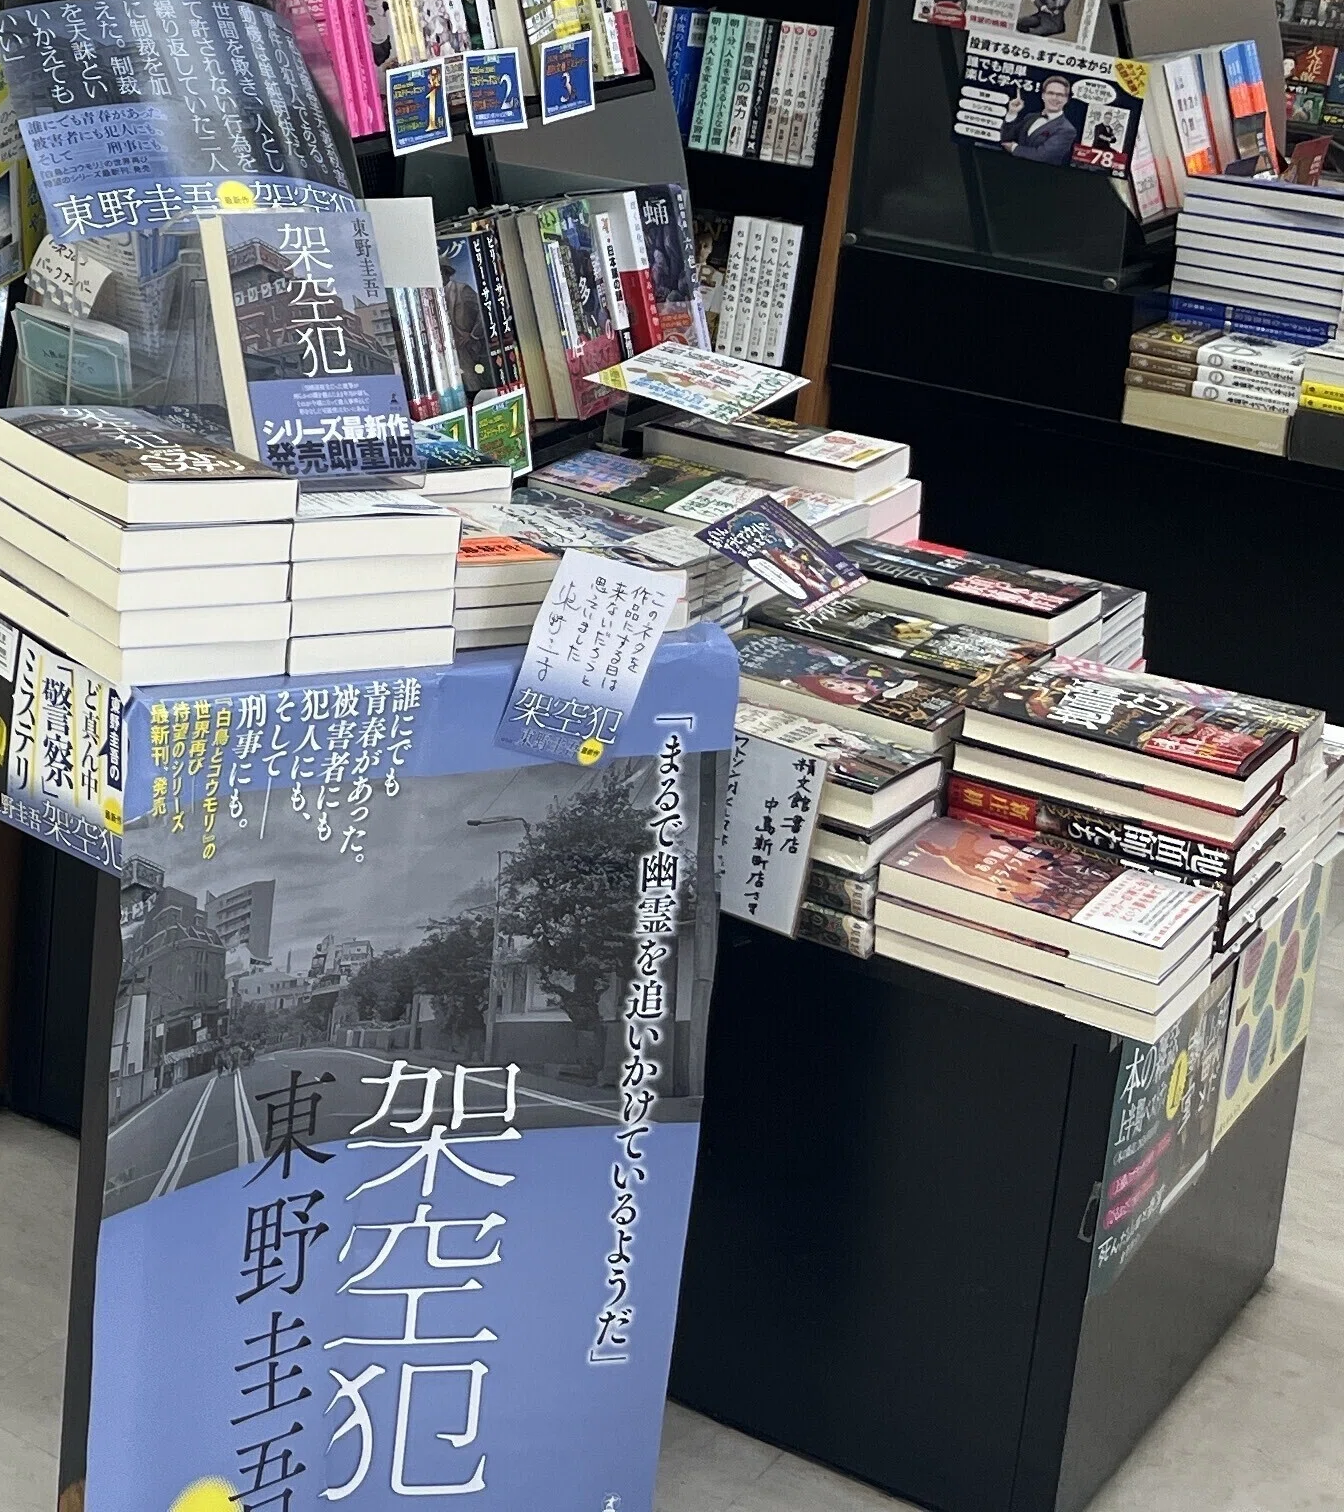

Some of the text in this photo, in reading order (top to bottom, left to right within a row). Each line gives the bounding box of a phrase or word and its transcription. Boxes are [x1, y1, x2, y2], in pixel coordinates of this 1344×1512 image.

[25, 9, 75, 105] いかえても
[60, 3, 108, 100] を天誅とい
[94, 1, 142, 97] えた。制裁
[123, 1, 172, 97] に制裁を加
[153, 0, 230, 173] 繰り返していた二人
[182, 0, 259, 173] て許されない行為を
[211, 0, 286, 173] 世間を欺き、人とし
[964, 68, 1043, 94] 楽しく学べる!
[965, 55, 1028, 77] 誰でも簡単
[969, 36, 1112, 75] 投資するなら、まずこの本から!
[351, 218, 379, 299] 東野圭吾
[642, 198, 671, 227] 蛹
[277, 223, 354, 378] 架空犯
[263, 414, 411, 446] シリーズ最新作
[266, 436, 418, 474] 発売即重版
[566, 576, 608, 662] 思っていました
[582, 582, 628, 687] 来ないだろうと
[602, 586, 652, 692] 作品にする日は
[628, 591, 665, 673] このネタを
[14, 647, 36, 791] ミステリ
[41, 664, 74, 798] 「警察」
[81, 679, 102, 801] ど真ん中
[228, 692, 268, 829] 刑事にも。
[288, 691, 330, 821] 犯人にも、
[314, 686, 361, 843] 被害者にも
[382, 678, 421, 797] 誰にでも
[509, 687, 623, 744] 架空犯
[201, 696, 233, 860] 『白鳥とコウモリ』の
[340, 682, 395, 864] 青春があった。
[780, 758, 817, 854] 精文館書店
[42, 799, 123, 872] 架空犯
[587, 710, 696, 1367] 「まるで幽霊を追いかけているようだ」
[228, 1068, 338, 1512] 東野圭吾
[318, 1058, 522, 1500] 架空犯
